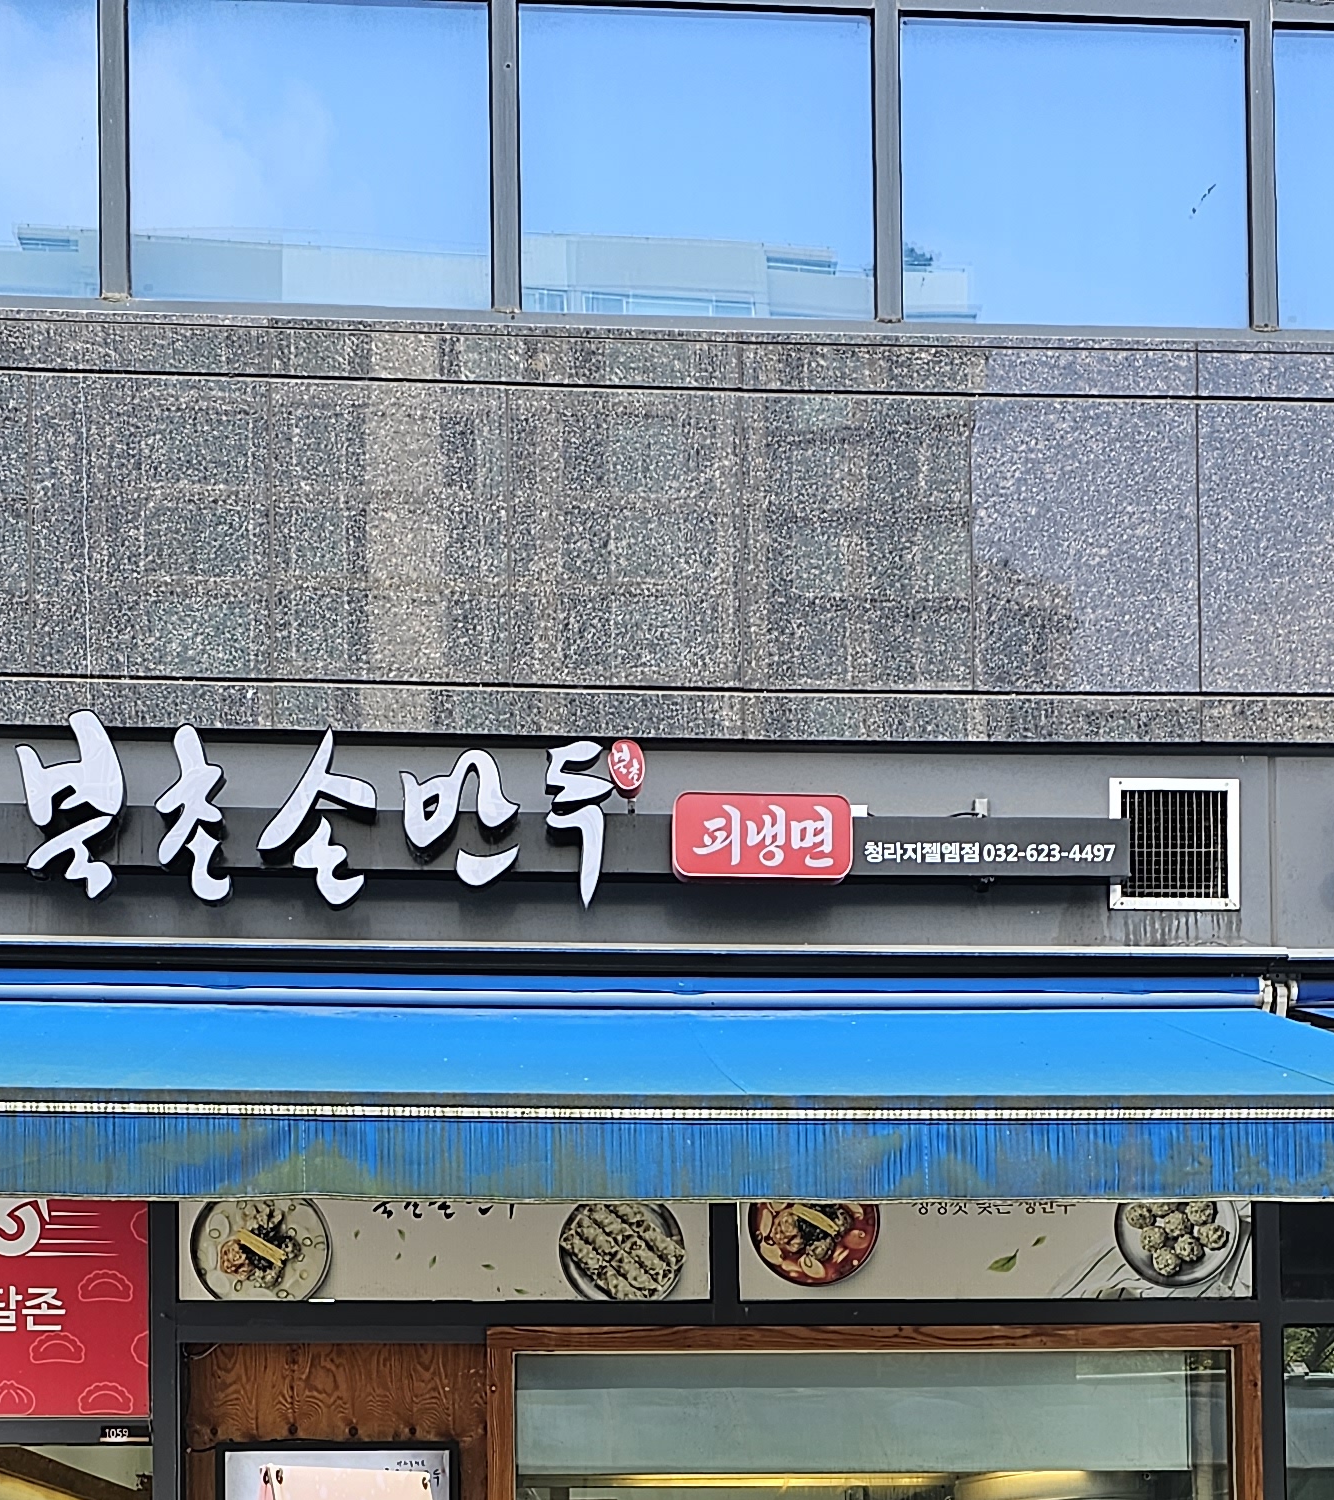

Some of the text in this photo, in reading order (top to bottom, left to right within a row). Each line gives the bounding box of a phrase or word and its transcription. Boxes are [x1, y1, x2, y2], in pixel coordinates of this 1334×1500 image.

[15, 708, 615, 910] 북촌손만두
[692, 805, 836, 870] 피냉면
[864, 841, 1116, 864] 청라지젤엠점 032-623-4497
[104, 1428, 130, 1439] 1059
